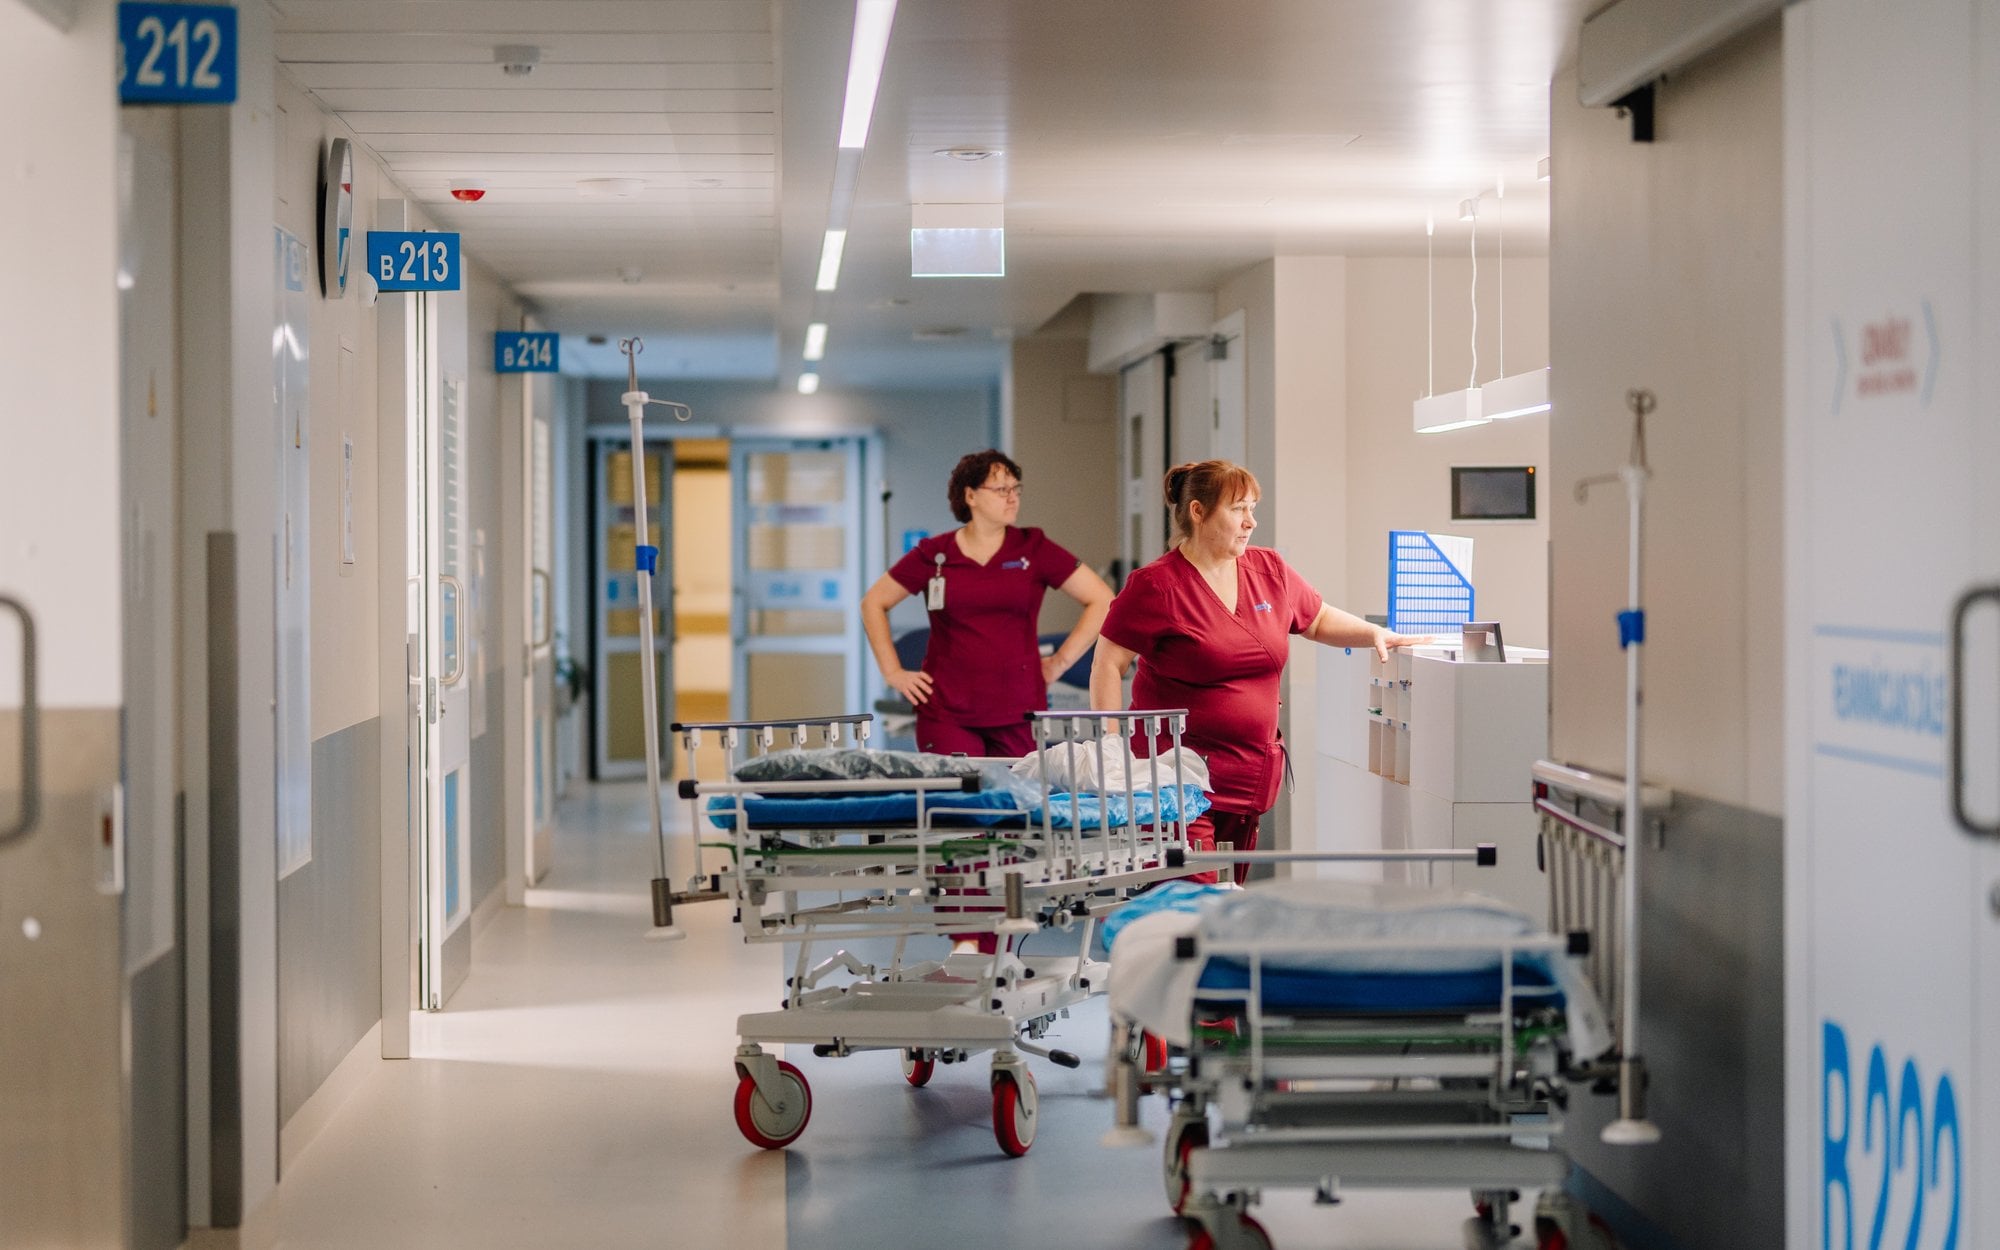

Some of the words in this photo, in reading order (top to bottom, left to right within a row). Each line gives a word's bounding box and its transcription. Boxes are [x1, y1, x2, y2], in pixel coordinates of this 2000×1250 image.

[136, 16, 221, 88] 212
[399, 240, 449, 282] 213
[517, 337, 552, 367] 214
